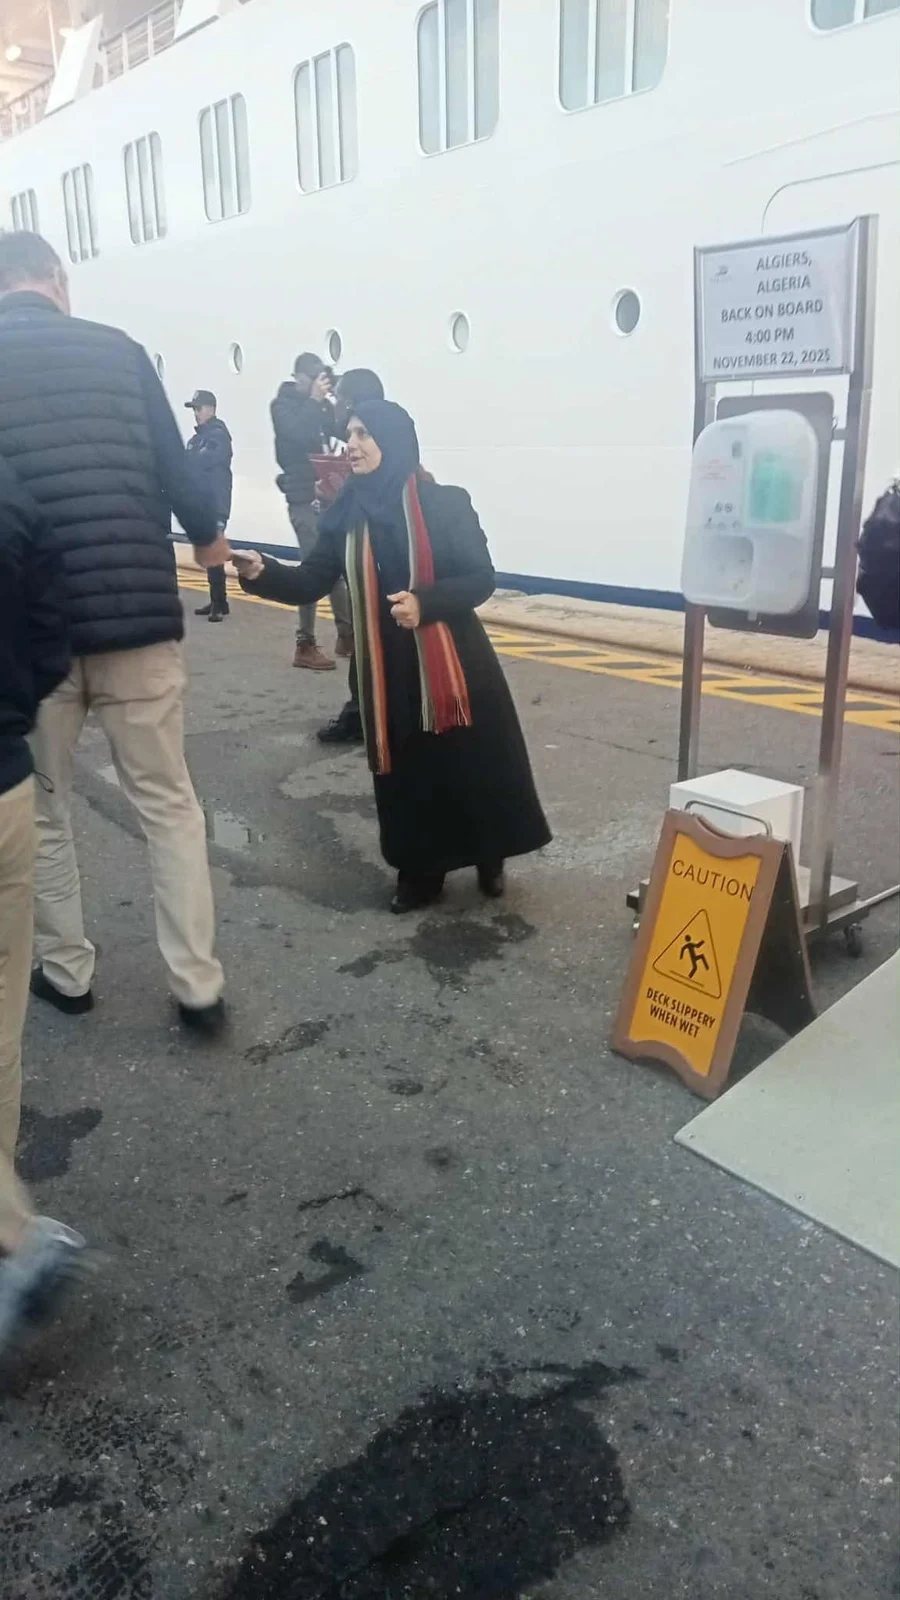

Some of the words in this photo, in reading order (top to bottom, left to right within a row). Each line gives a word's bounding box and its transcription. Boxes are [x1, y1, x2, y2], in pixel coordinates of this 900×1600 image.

[756, 251, 812, 271] ALGIERS,
[757, 275, 811, 294] ALGERIA
[721, 307, 752, 323] BACK
[755, 304, 774, 319] ON
[778, 299, 823, 316] BOARD
[745, 329, 771, 344] 4:00
[774, 327, 794, 342] PM
[713, 353, 777, 369] NOVEMBER
[781, 351, 797, 366] 22,
[802, 348, 830, 363] 2025
[672, 860, 755, 902] CAUTION
[646, 987, 670, 1007] DECK
[671, 999, 716, 1029] SLIPPERY
[650, 1005, 678, 1028] WHEN
[679, 1018, 700, 1039] WET
